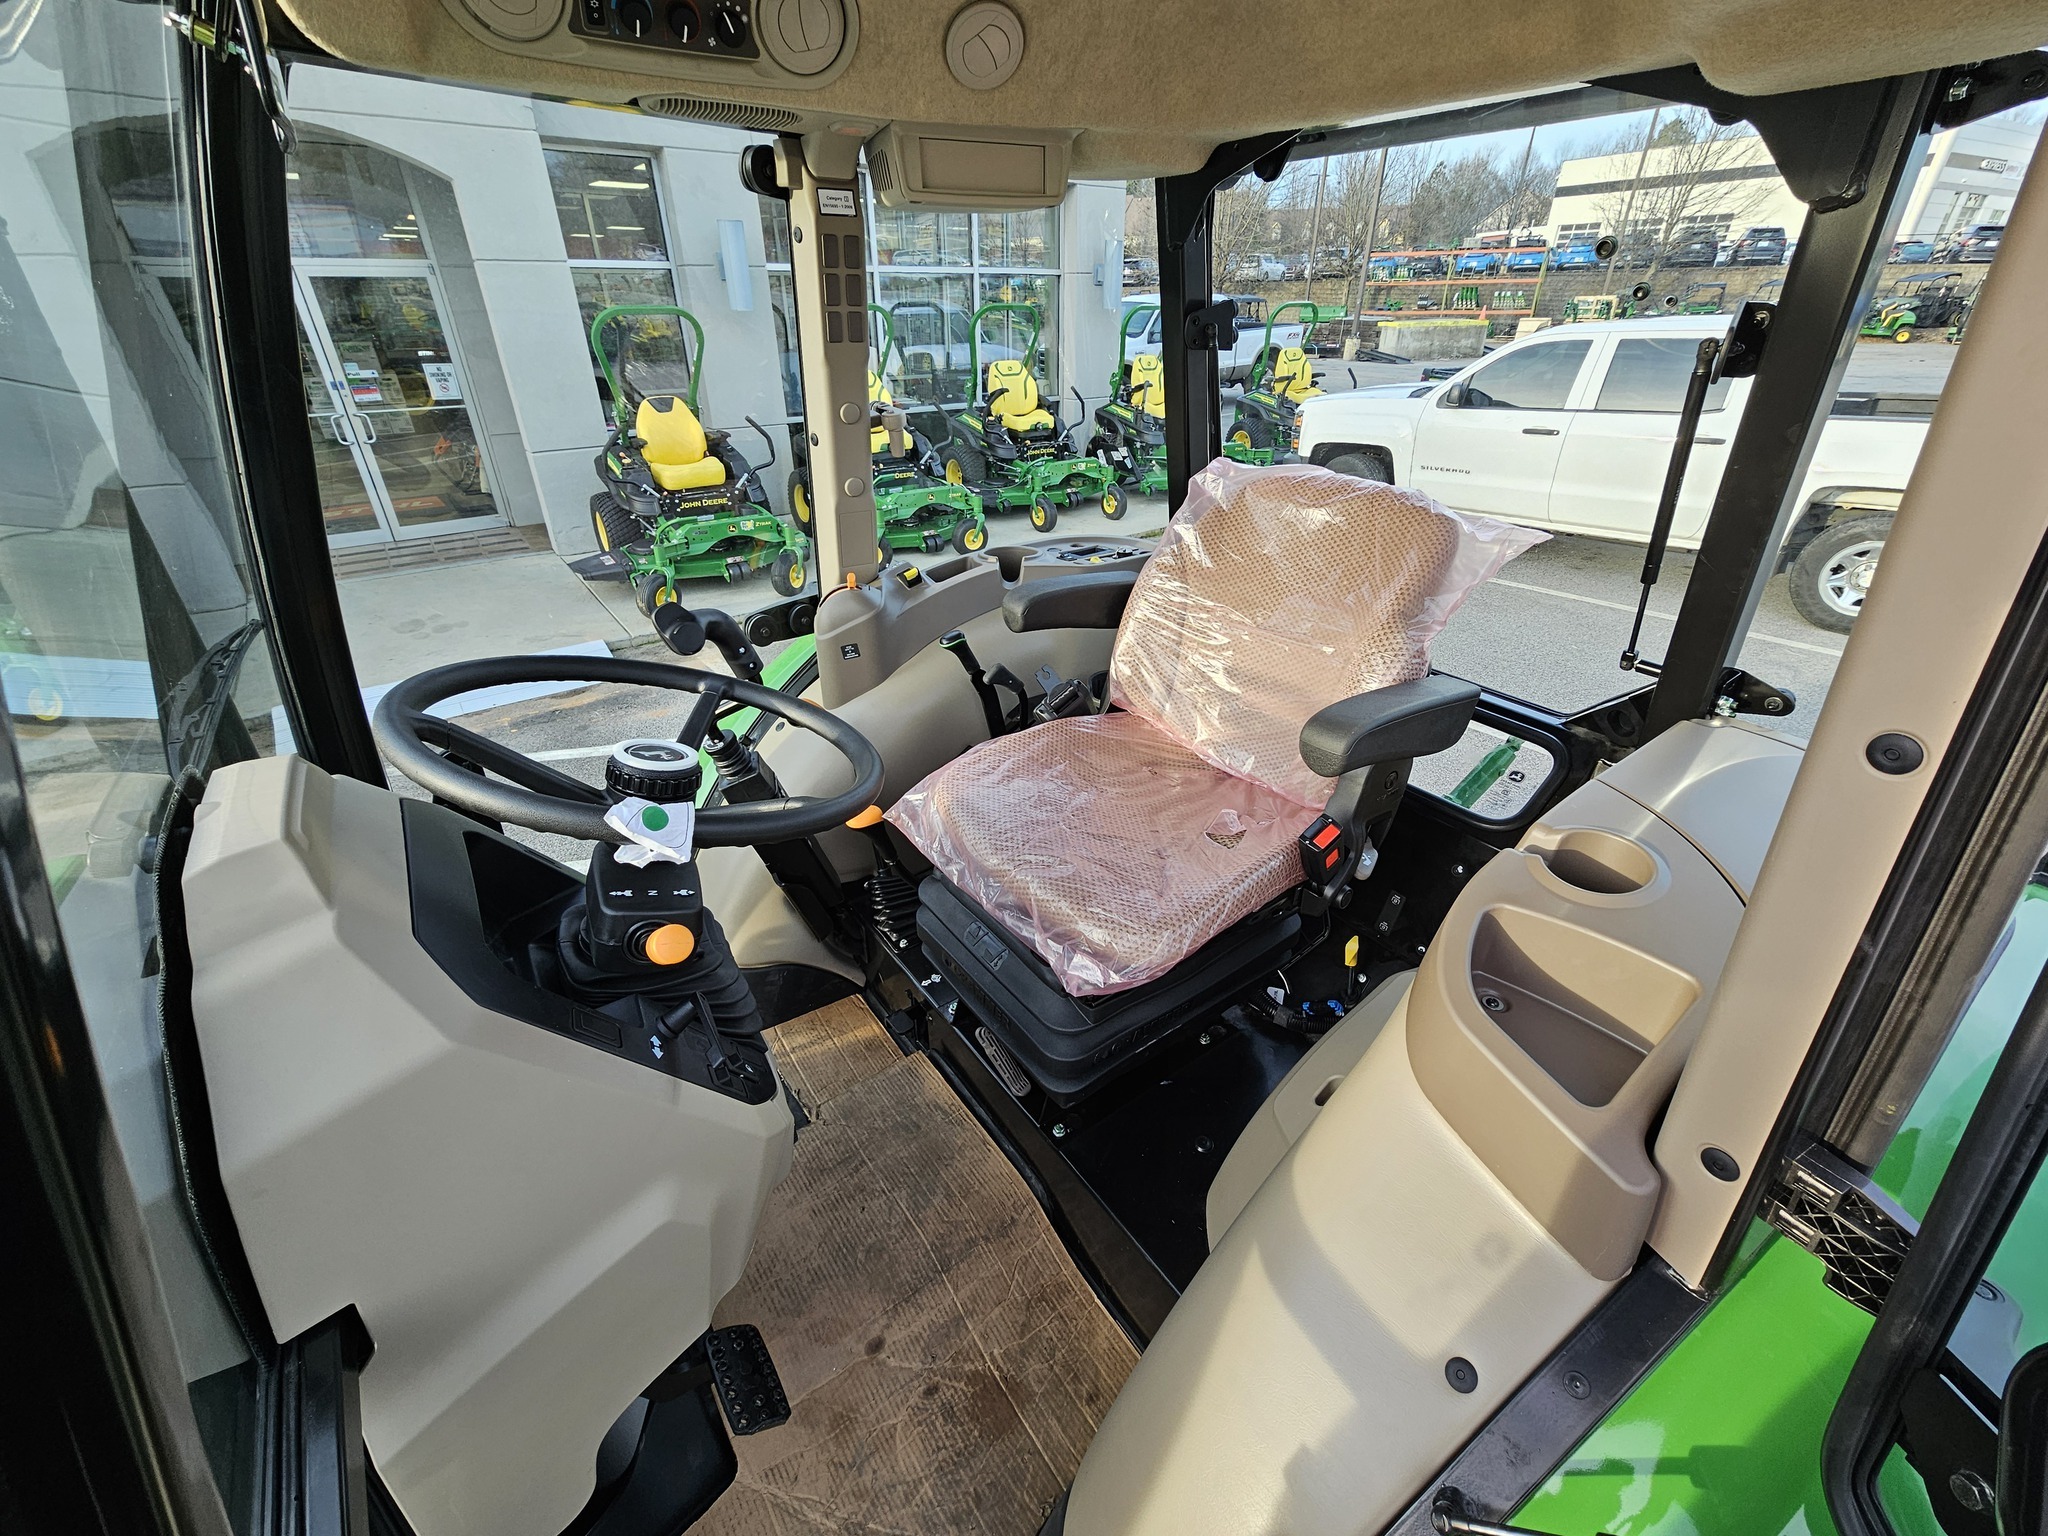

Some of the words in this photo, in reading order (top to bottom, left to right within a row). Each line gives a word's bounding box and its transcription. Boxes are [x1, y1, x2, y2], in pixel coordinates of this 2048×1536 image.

[894, 471, 916, 479] DEERE
[1420, 465, 1471, 475] SILVERADO
[680, 500, 702, 509] JOHN
[702, 497, 728, 507] DEERE
